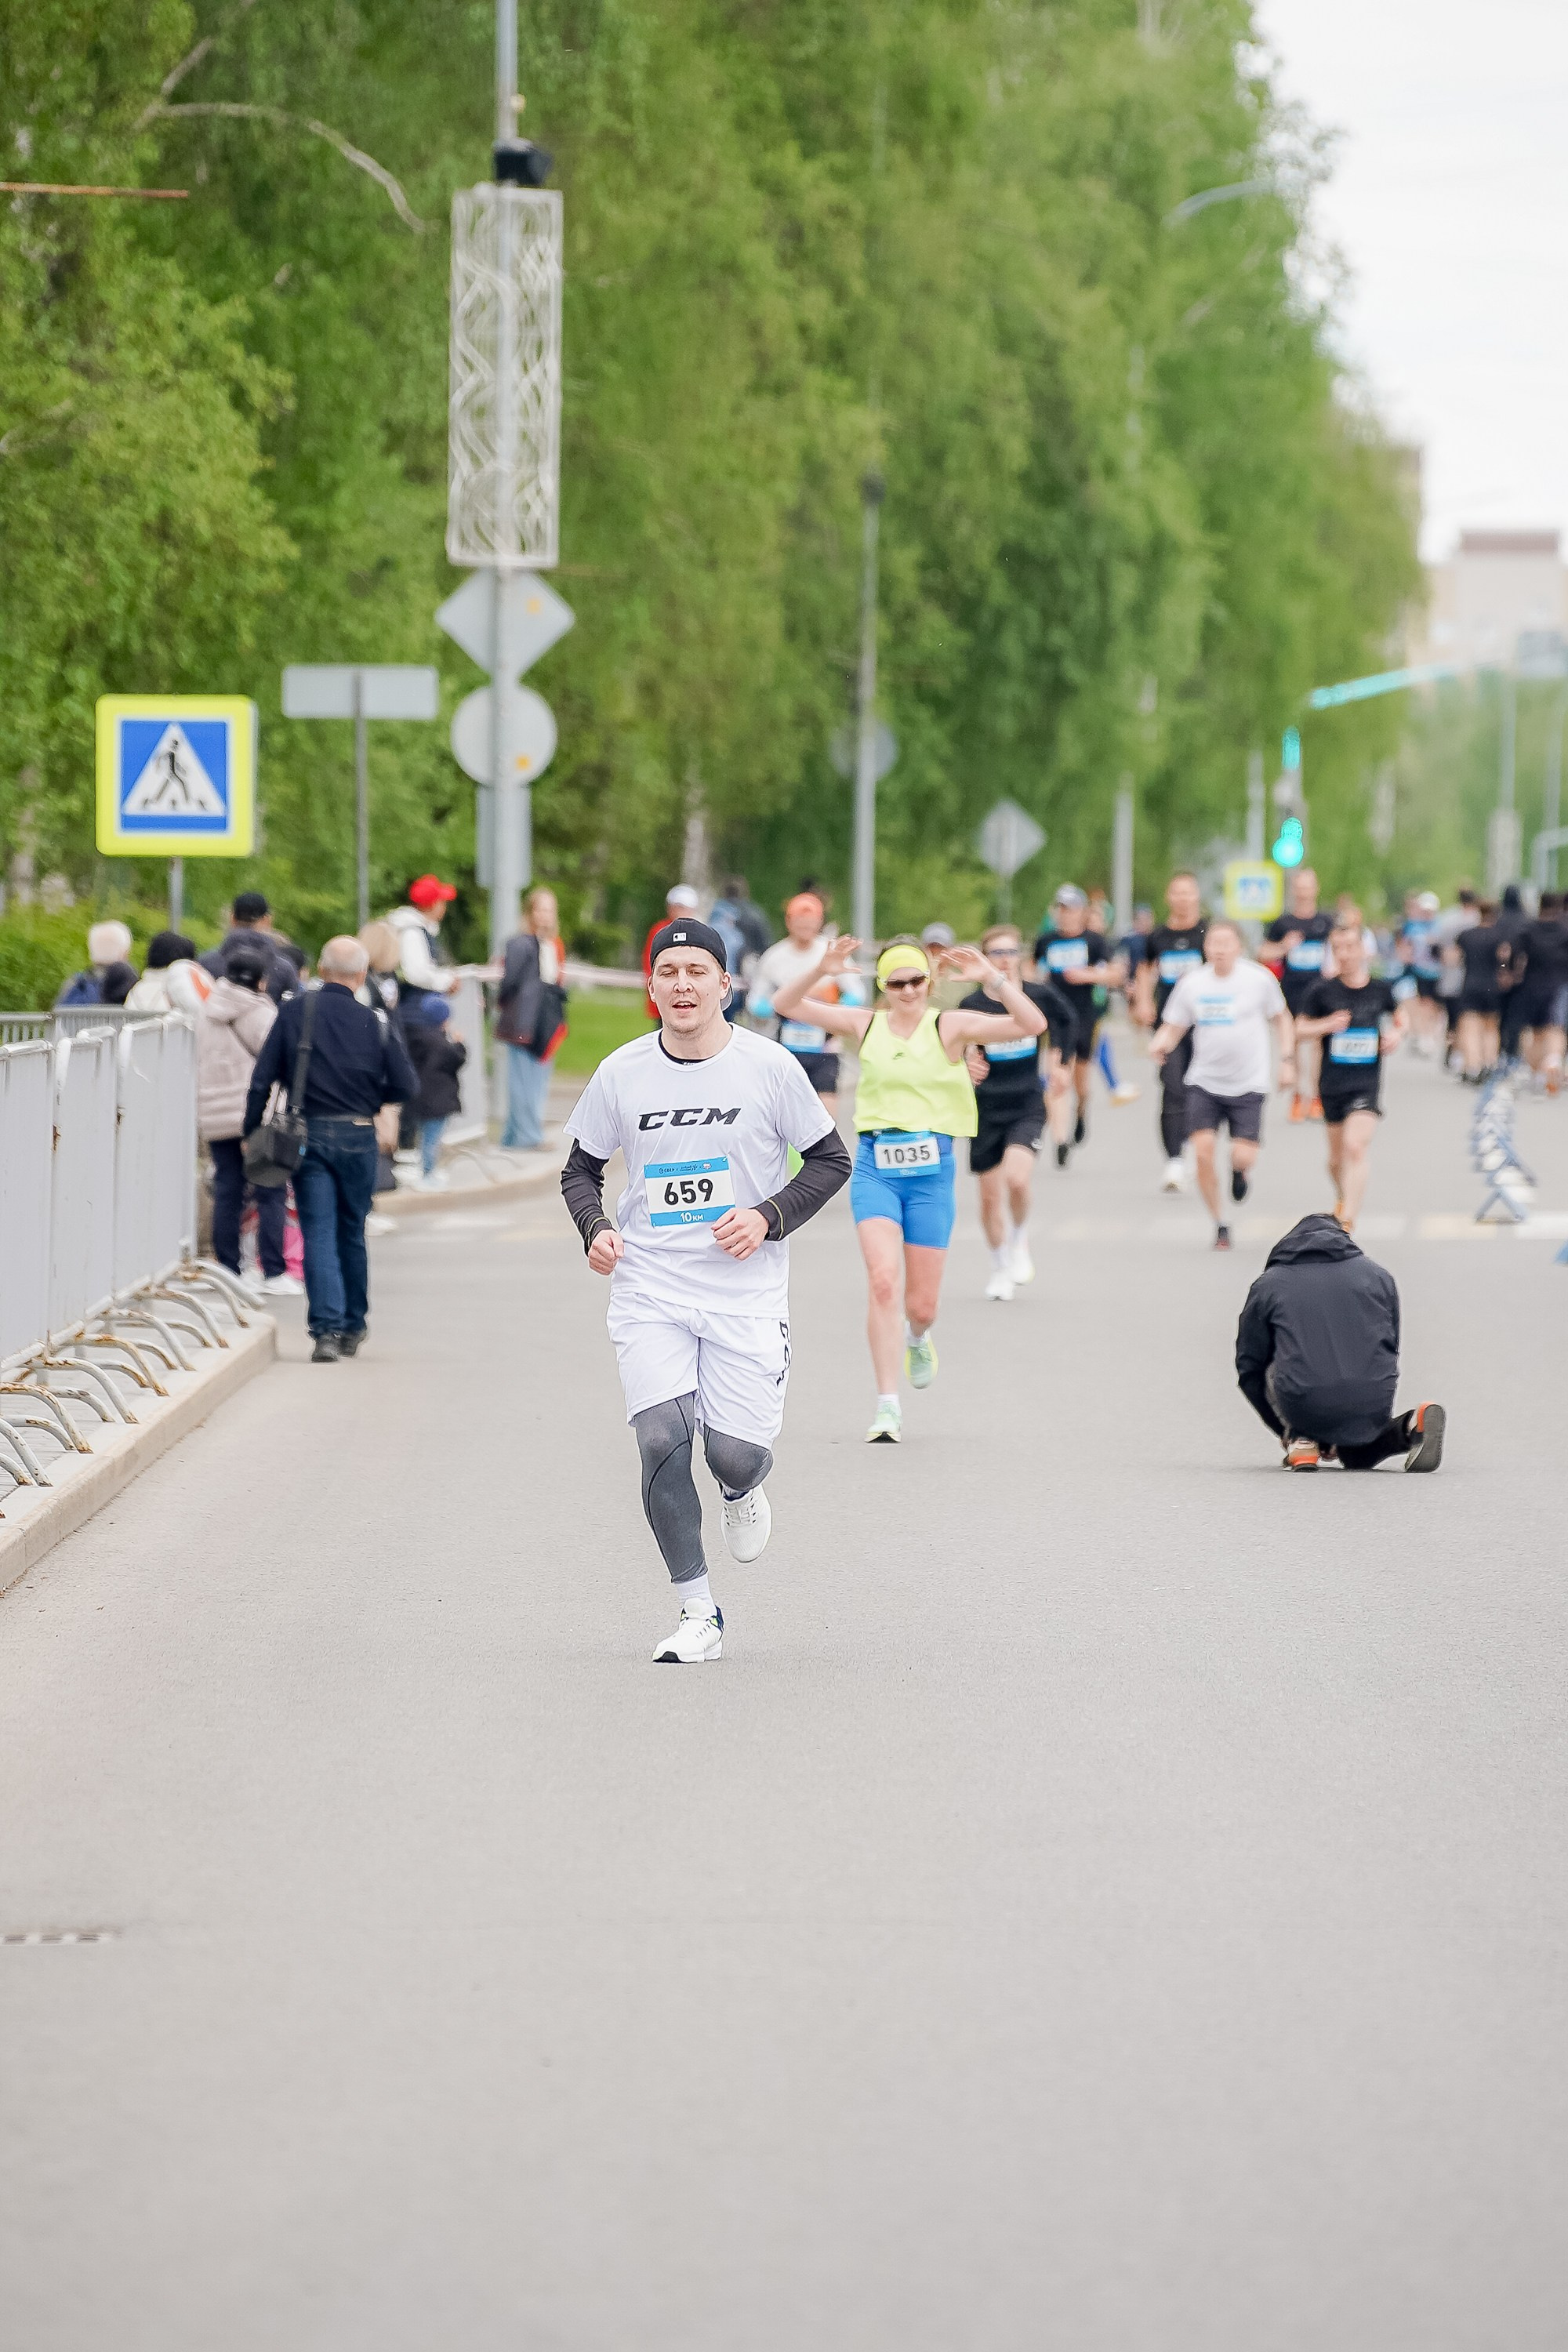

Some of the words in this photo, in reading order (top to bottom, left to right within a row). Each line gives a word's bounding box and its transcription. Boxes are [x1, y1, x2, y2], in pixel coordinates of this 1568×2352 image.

[638, 1108, 741, 1131] CCM
[883, 1145, 931, 1164] 1035
[664, 1178, 713, 1205] 659
